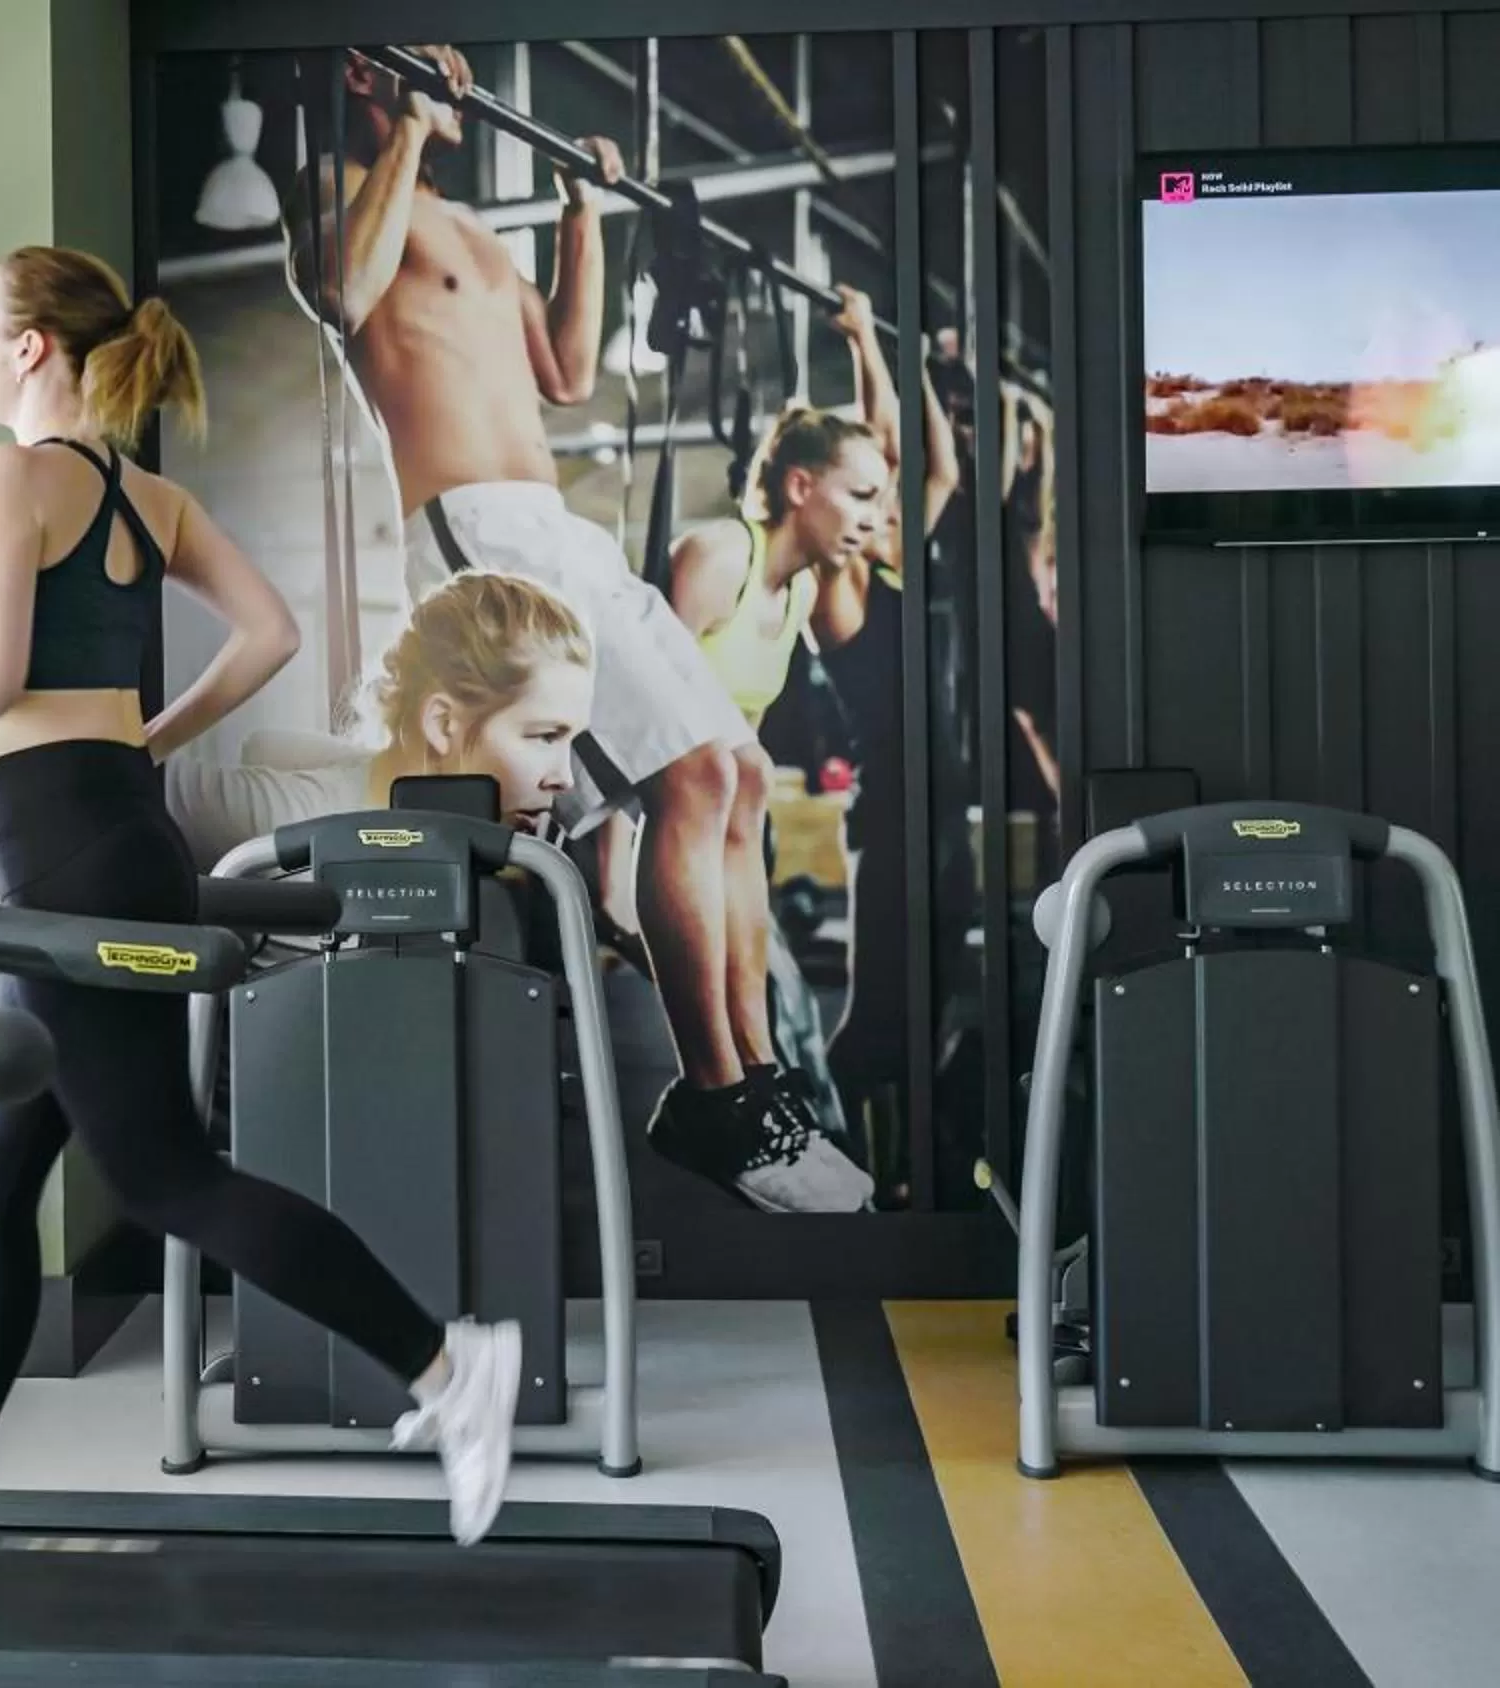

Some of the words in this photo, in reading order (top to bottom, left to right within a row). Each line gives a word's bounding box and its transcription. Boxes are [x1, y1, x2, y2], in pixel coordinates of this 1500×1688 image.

[1201, 184, 1227, 193] Rock
[1228, 183, 1253, 193] Solid
[1254, 181, 1293, 193] Playlist
[1222, 881, 1317, 891] SELECTION
[345, 887, 437, 898] SELECTION
